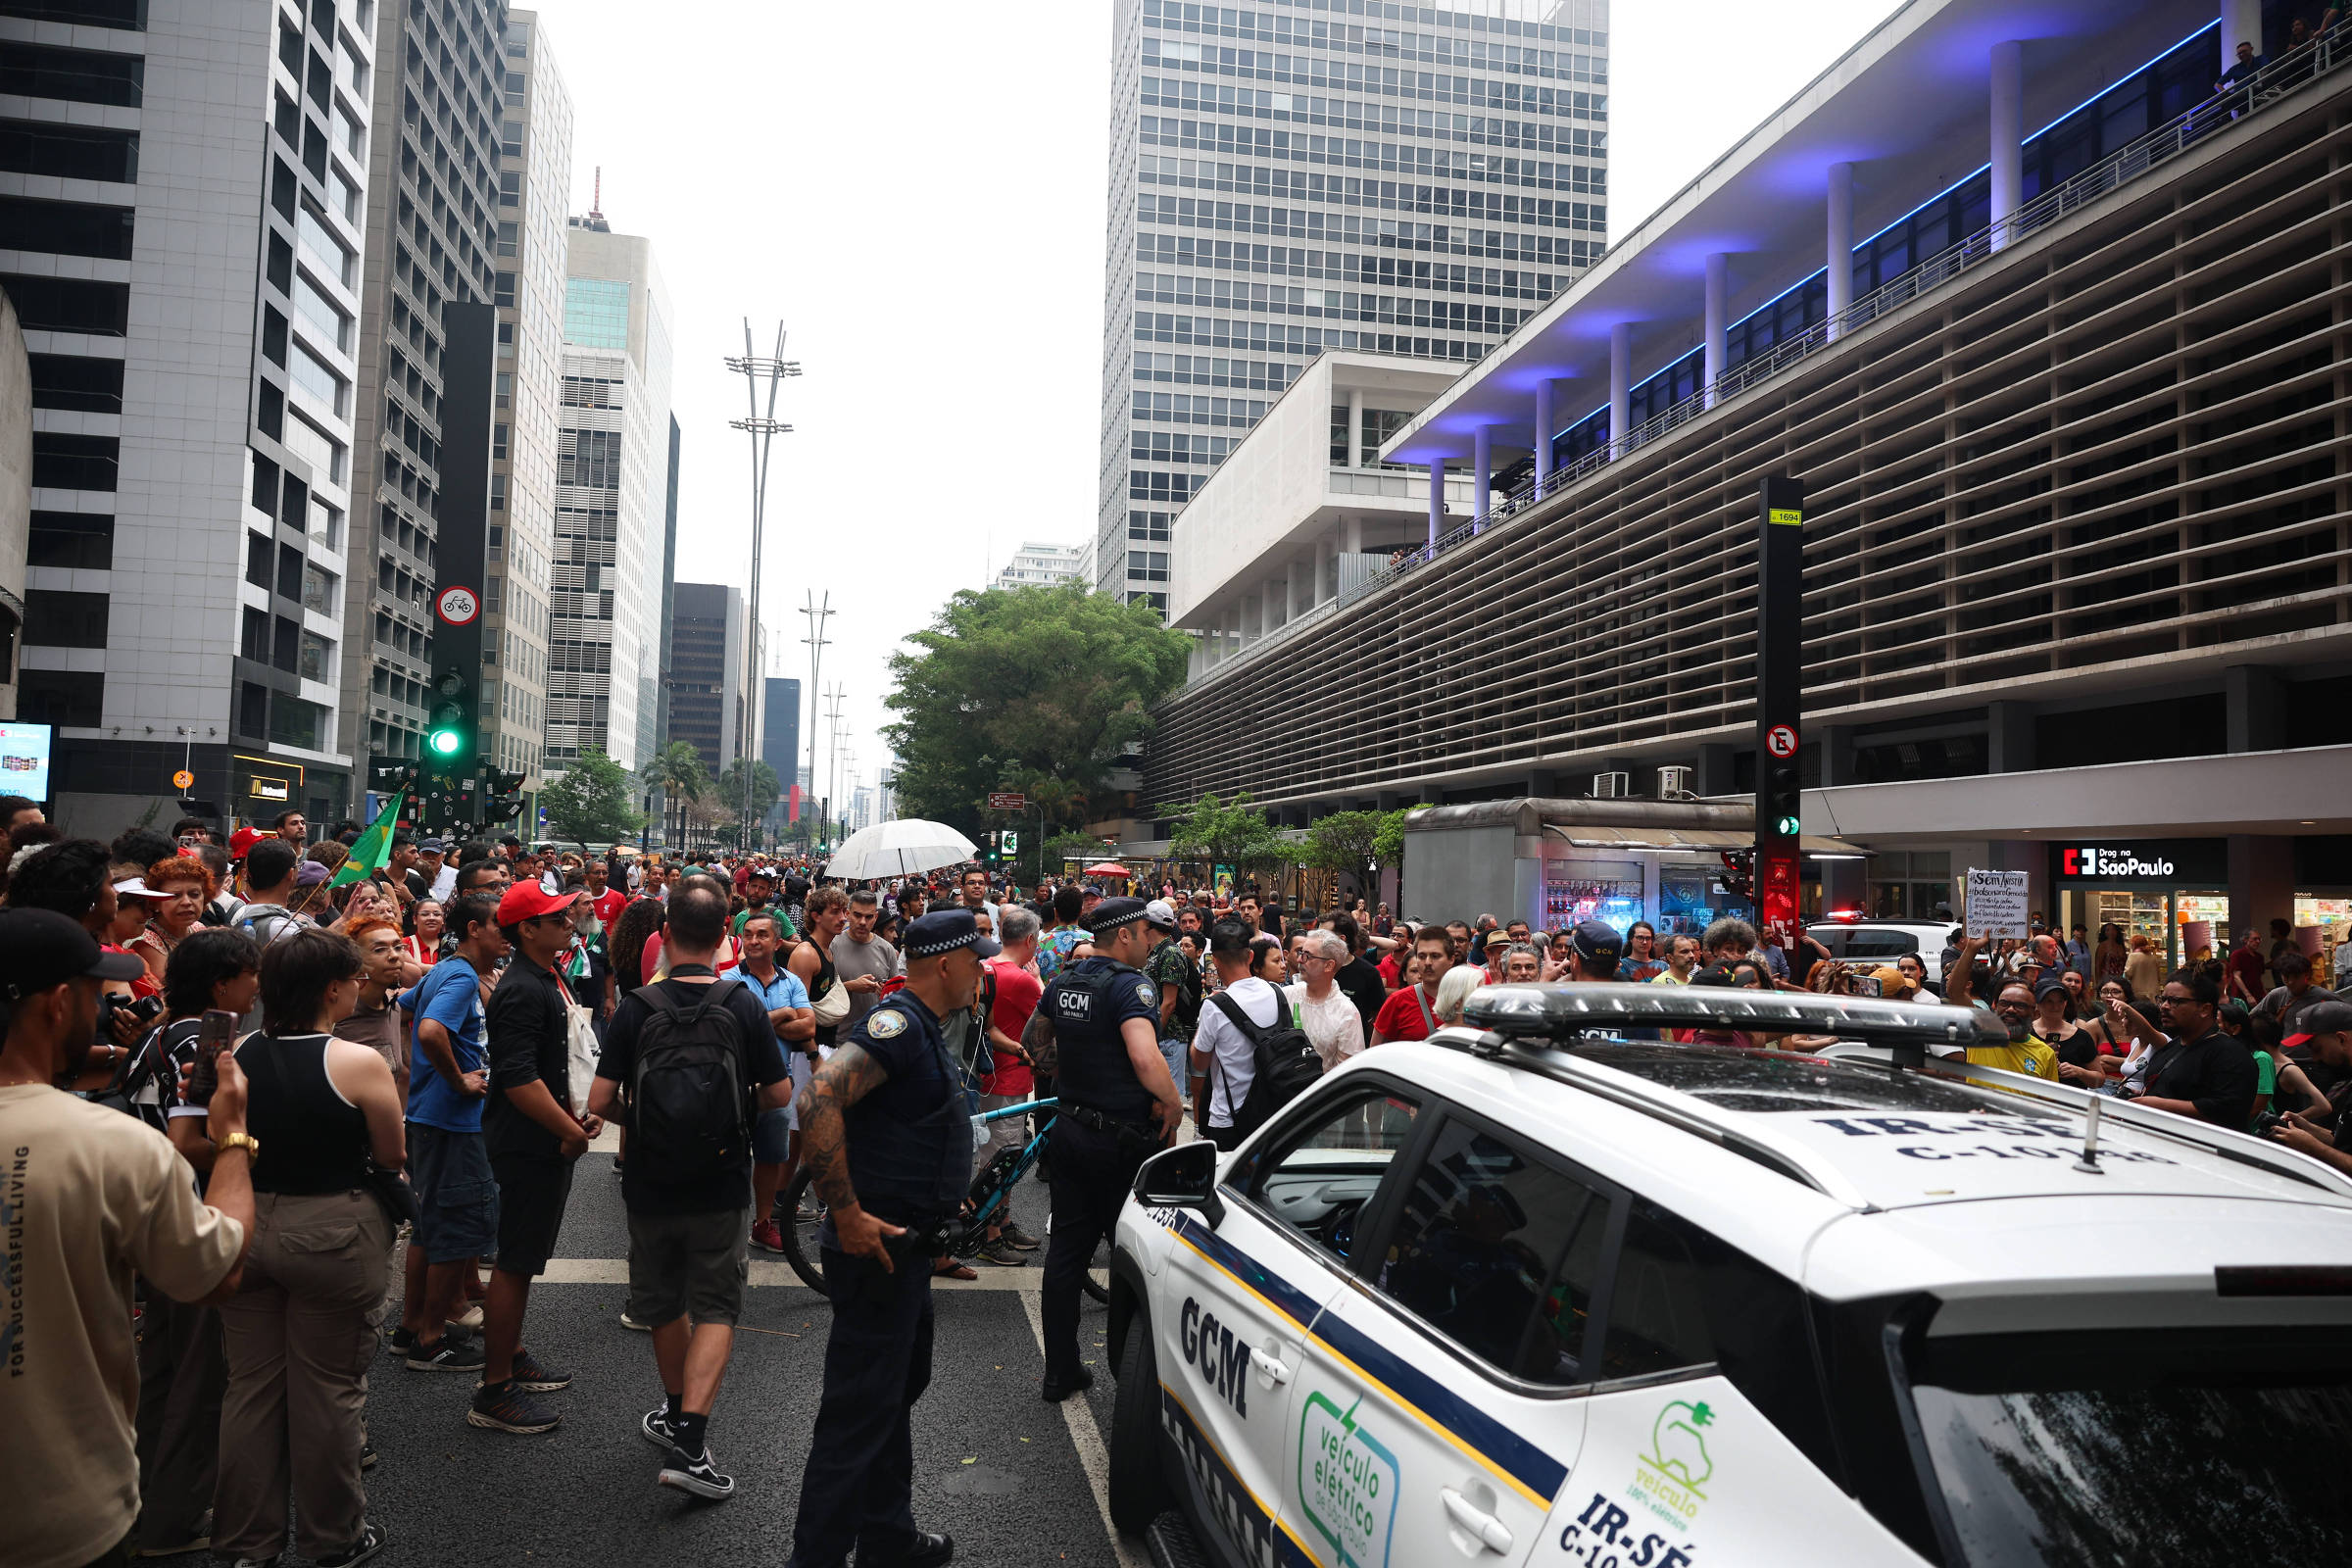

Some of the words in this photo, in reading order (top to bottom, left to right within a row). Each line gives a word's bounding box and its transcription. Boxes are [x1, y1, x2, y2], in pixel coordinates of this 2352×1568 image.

[1780, 513, 1798, 521] 1694
[1058, 992, 1090, 1011] GCM
[10, 1144, 29, 1210] LIVING
[9, 1211, 24, 1335] SUCCESSFUL
[11, 1338, 24, 1377] FOR
[1181, 1297, 1250, 1420] GCM
[1321, 1426, 1379, 1498] veículo
[1314, 1460, 1373, 1537] elétrico
[1636, 1467, 1697, 1518] veículo
[1344, 1517, 1367, 1557] Paulo
